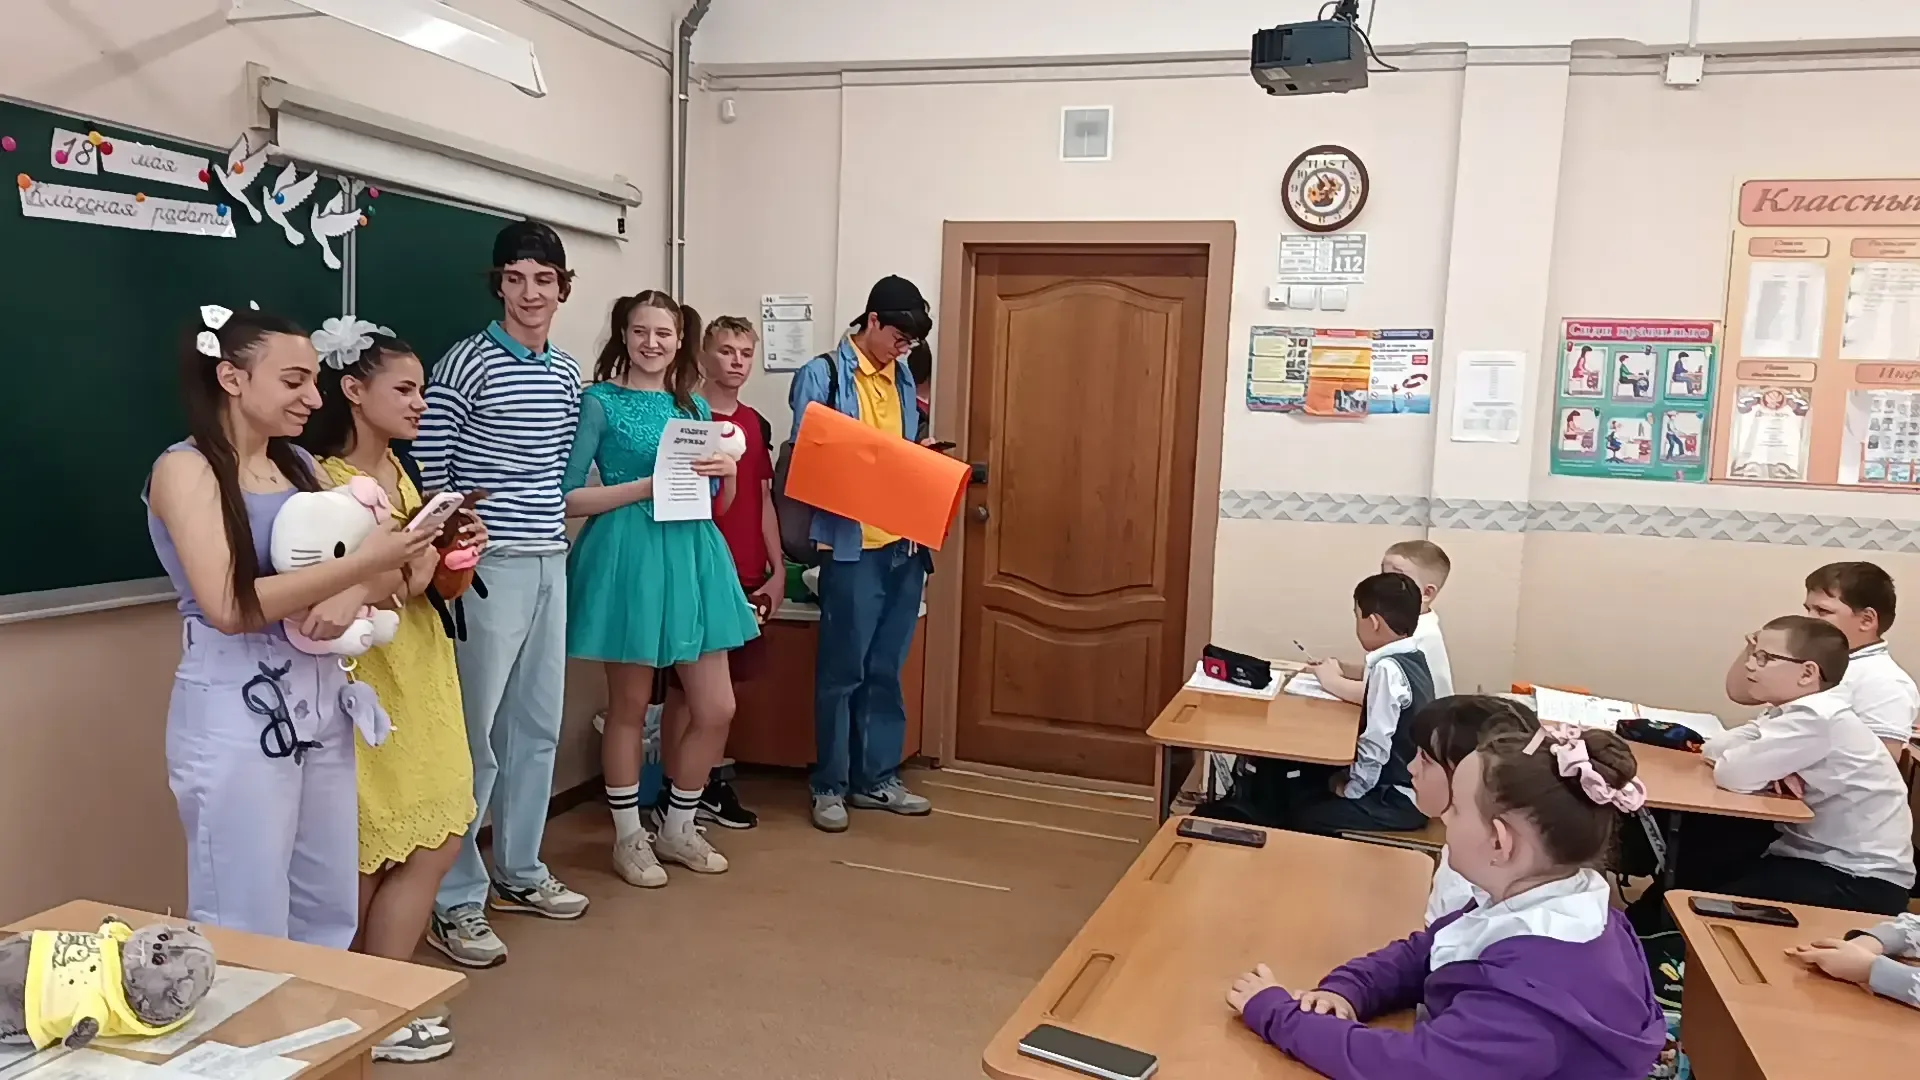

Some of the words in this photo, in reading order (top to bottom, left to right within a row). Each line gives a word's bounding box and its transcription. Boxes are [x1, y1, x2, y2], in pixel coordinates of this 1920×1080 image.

[62, 137, 94, 166] 18
[131, 153, 178, 173] мая
[1334, 256, 1363, 272] 112
